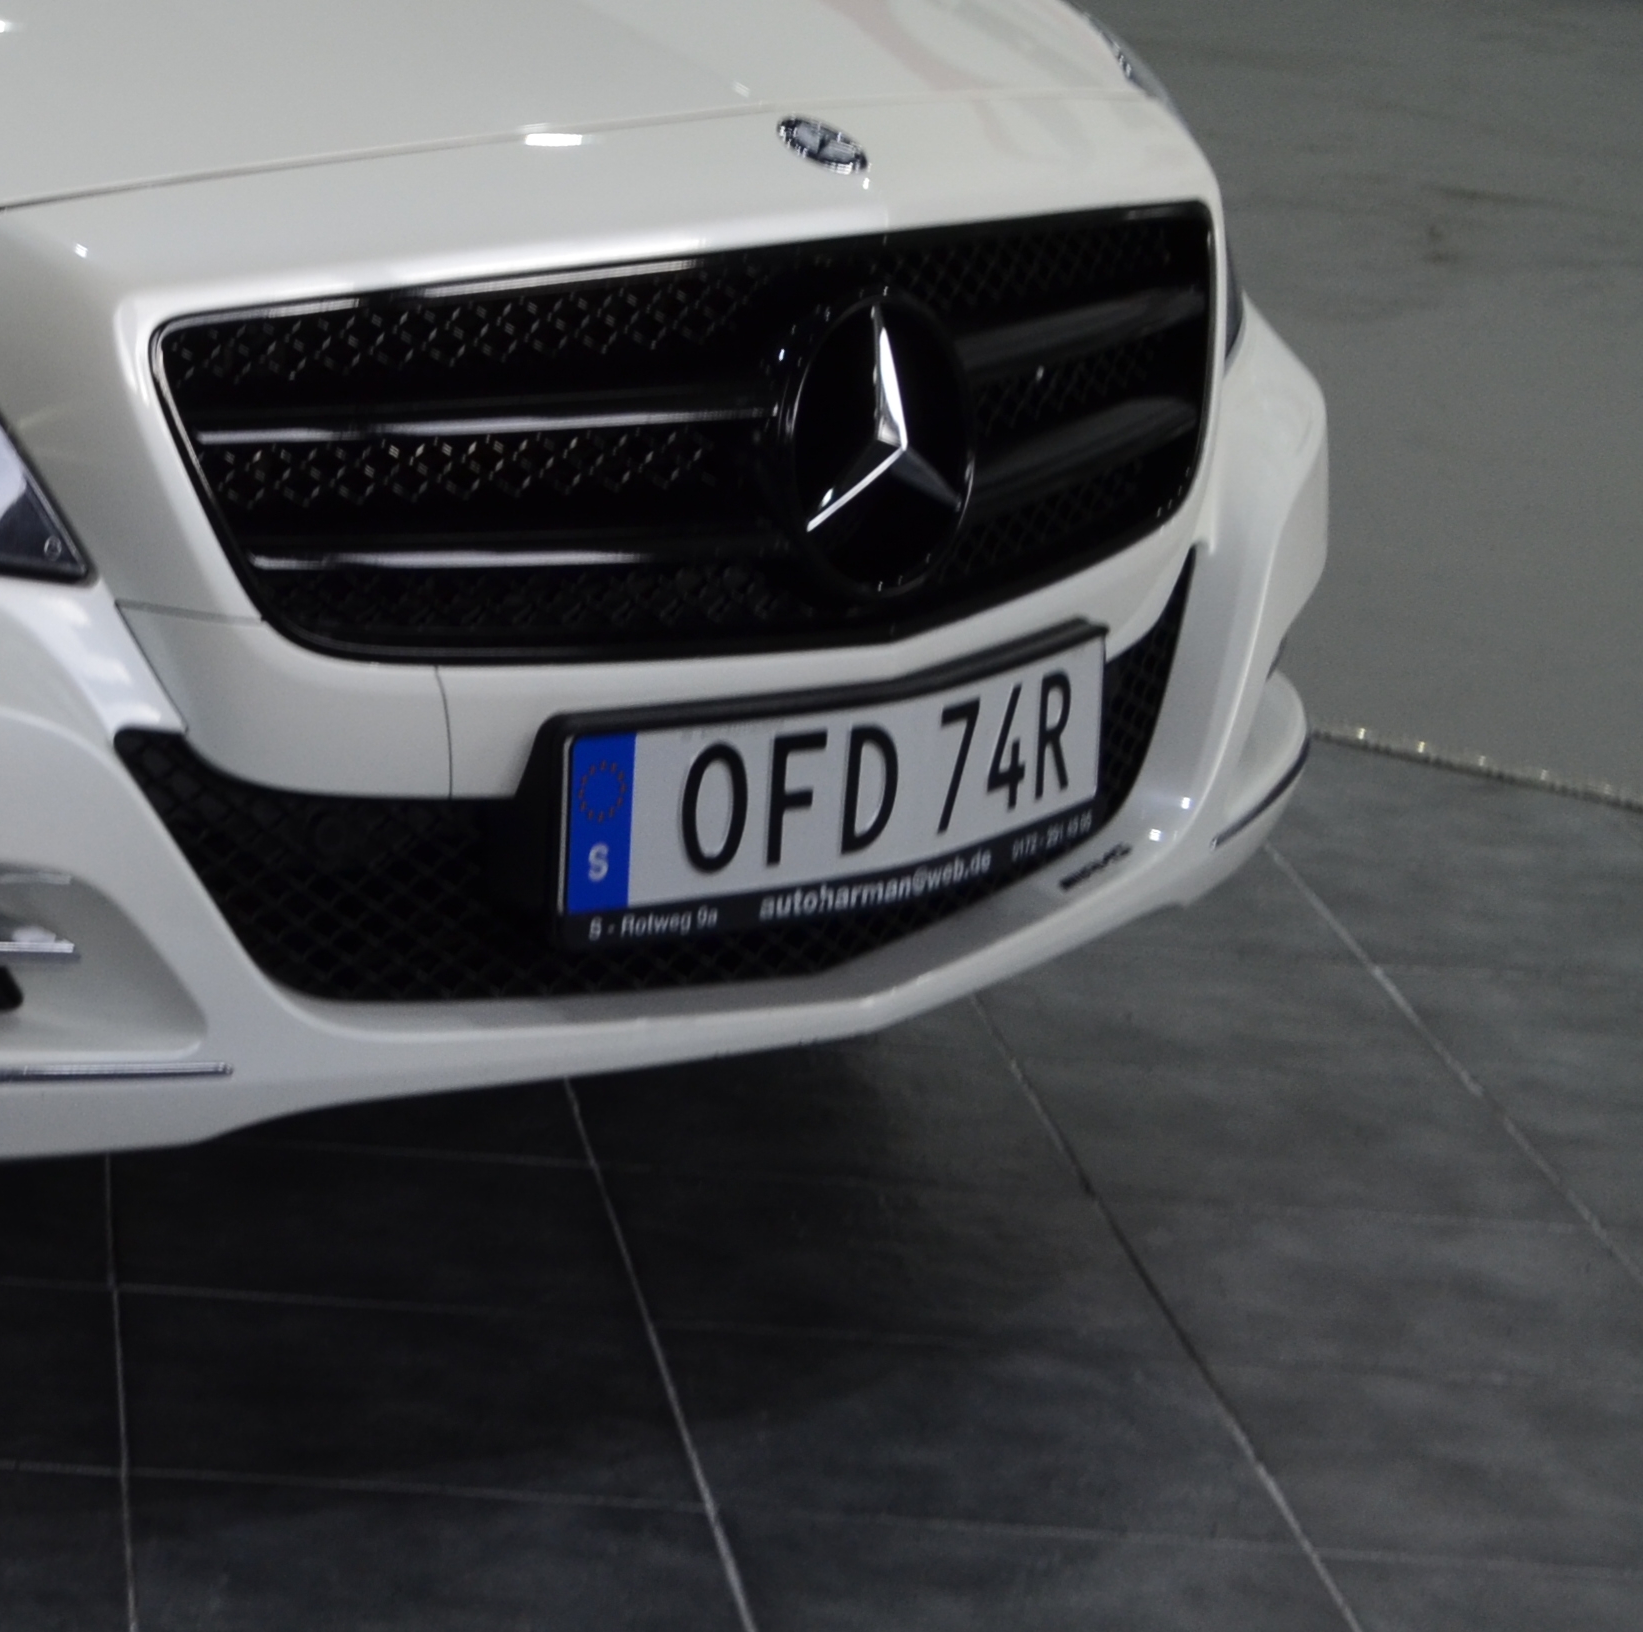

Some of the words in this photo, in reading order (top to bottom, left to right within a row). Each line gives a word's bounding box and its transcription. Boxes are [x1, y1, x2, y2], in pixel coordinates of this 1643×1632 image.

[681, 727, 900, 873] OFD
[936, 669, 1073, 835] 74R
[588, 842, 609, 883] S
[759, 848, 992, 921] autoharman@web.de
